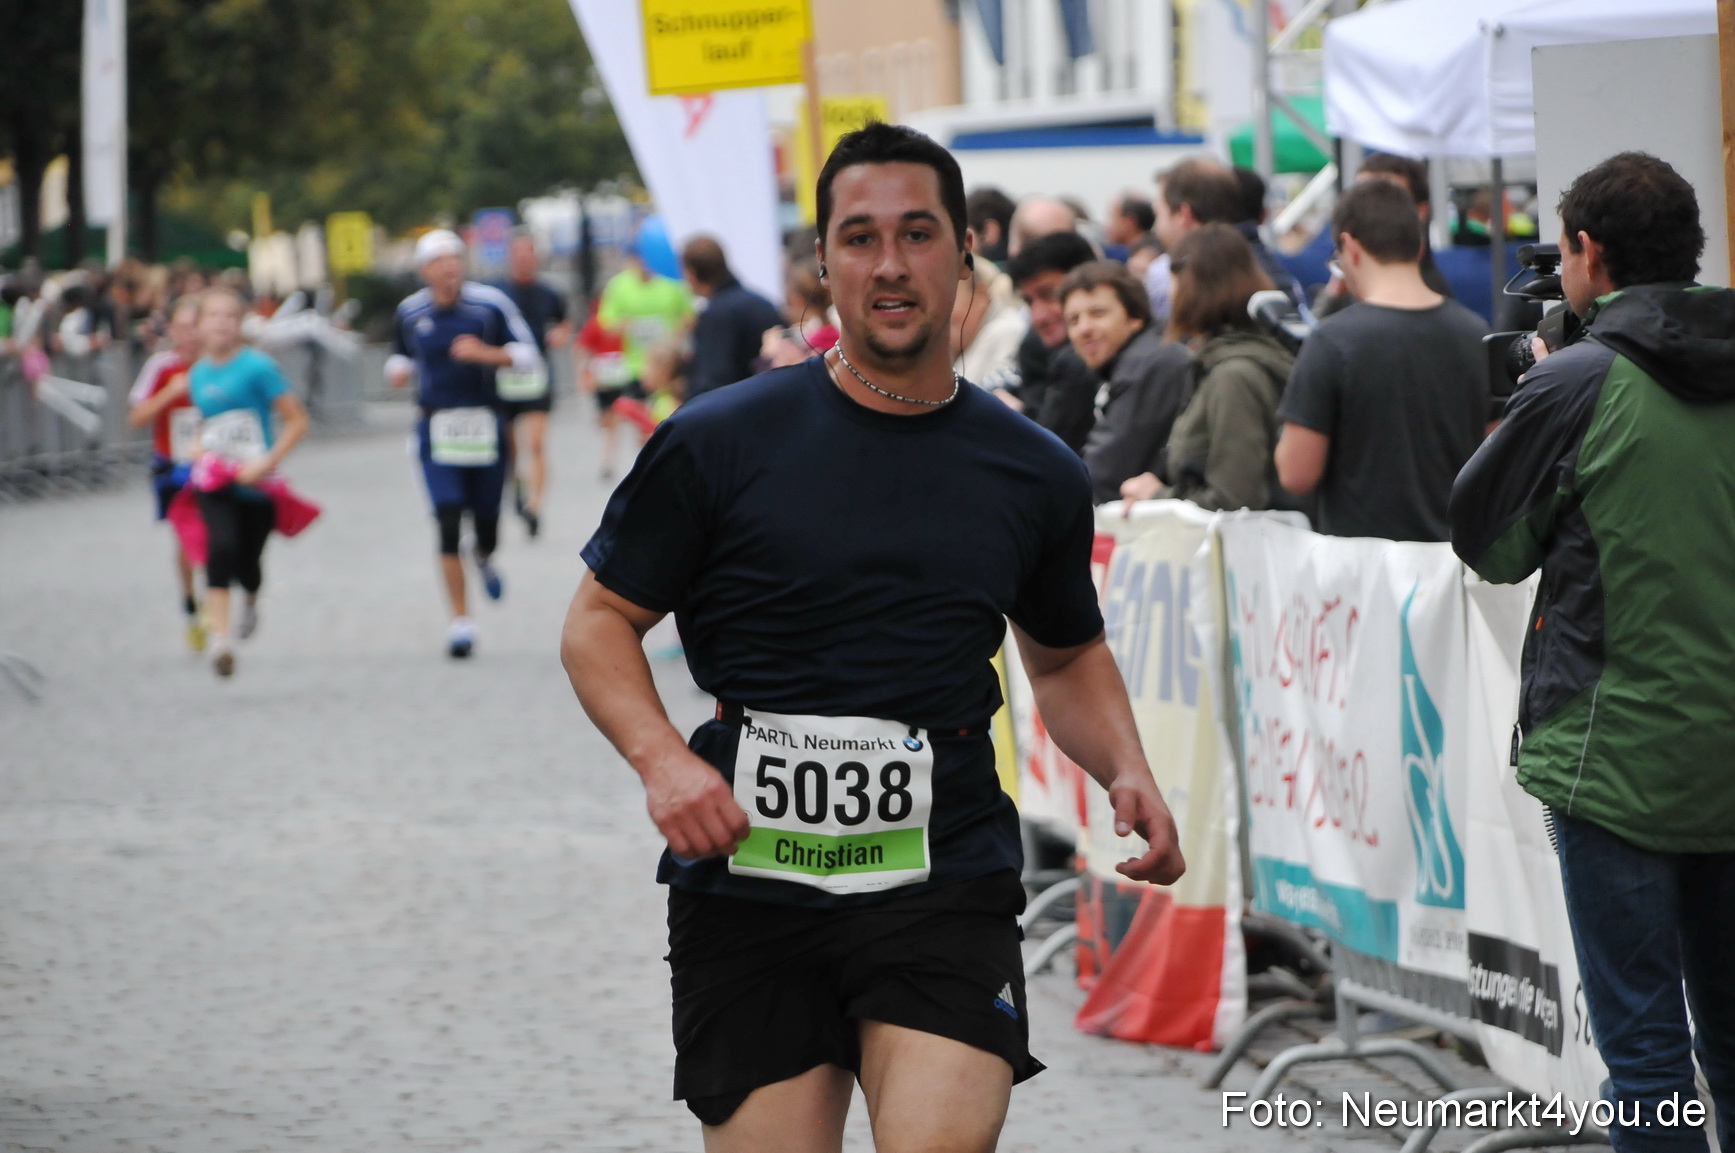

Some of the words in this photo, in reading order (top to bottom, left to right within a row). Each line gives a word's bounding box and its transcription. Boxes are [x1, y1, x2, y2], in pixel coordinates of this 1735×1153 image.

[652, 8, 797, 35] Schnupper-
[703, 40, 752, 62] lauf
[745, 725, 798, 749] PARTL
[804, 735, 897, 751] Neumarkt
[755, 754, 913, 826] 5038
[775, 838, 884, 869] Christian
